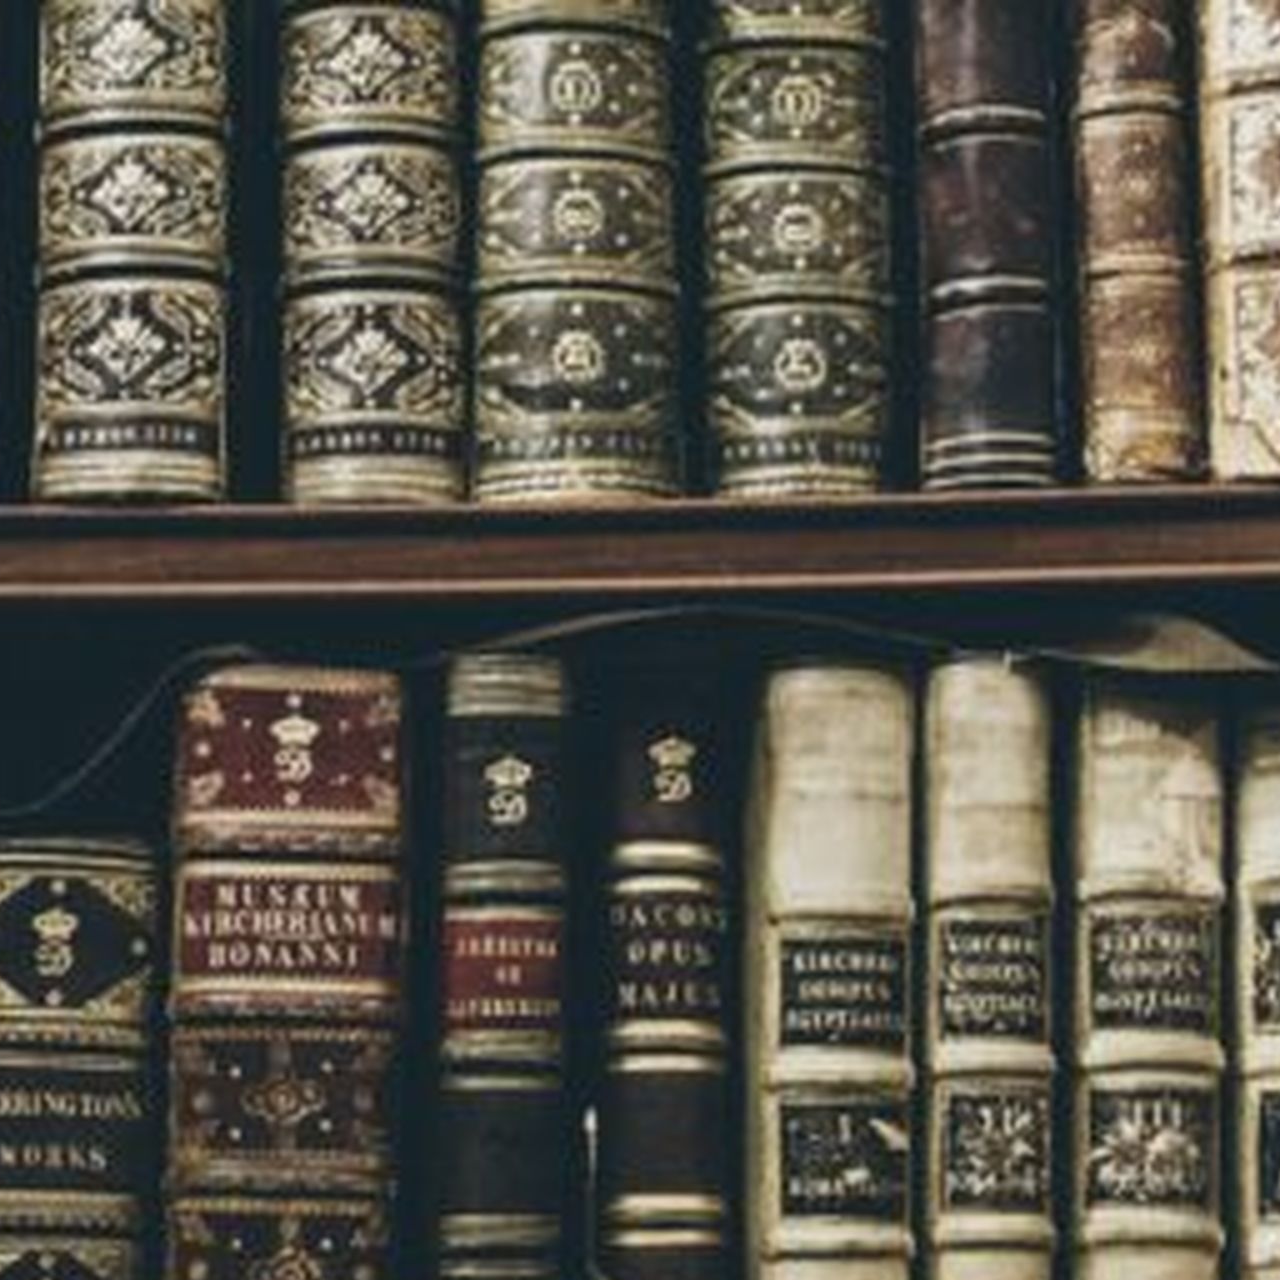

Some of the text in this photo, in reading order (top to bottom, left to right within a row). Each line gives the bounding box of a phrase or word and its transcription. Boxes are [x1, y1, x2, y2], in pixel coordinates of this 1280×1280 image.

[218, 882, 361, 910] MUSEUM
[208, 941, 361, 969] BONANNI
[626, 939, 714, 967] OPUS
[618, 981, 722, 1009] MAJUS
[0, 1143, 108, 1170] WORKS
